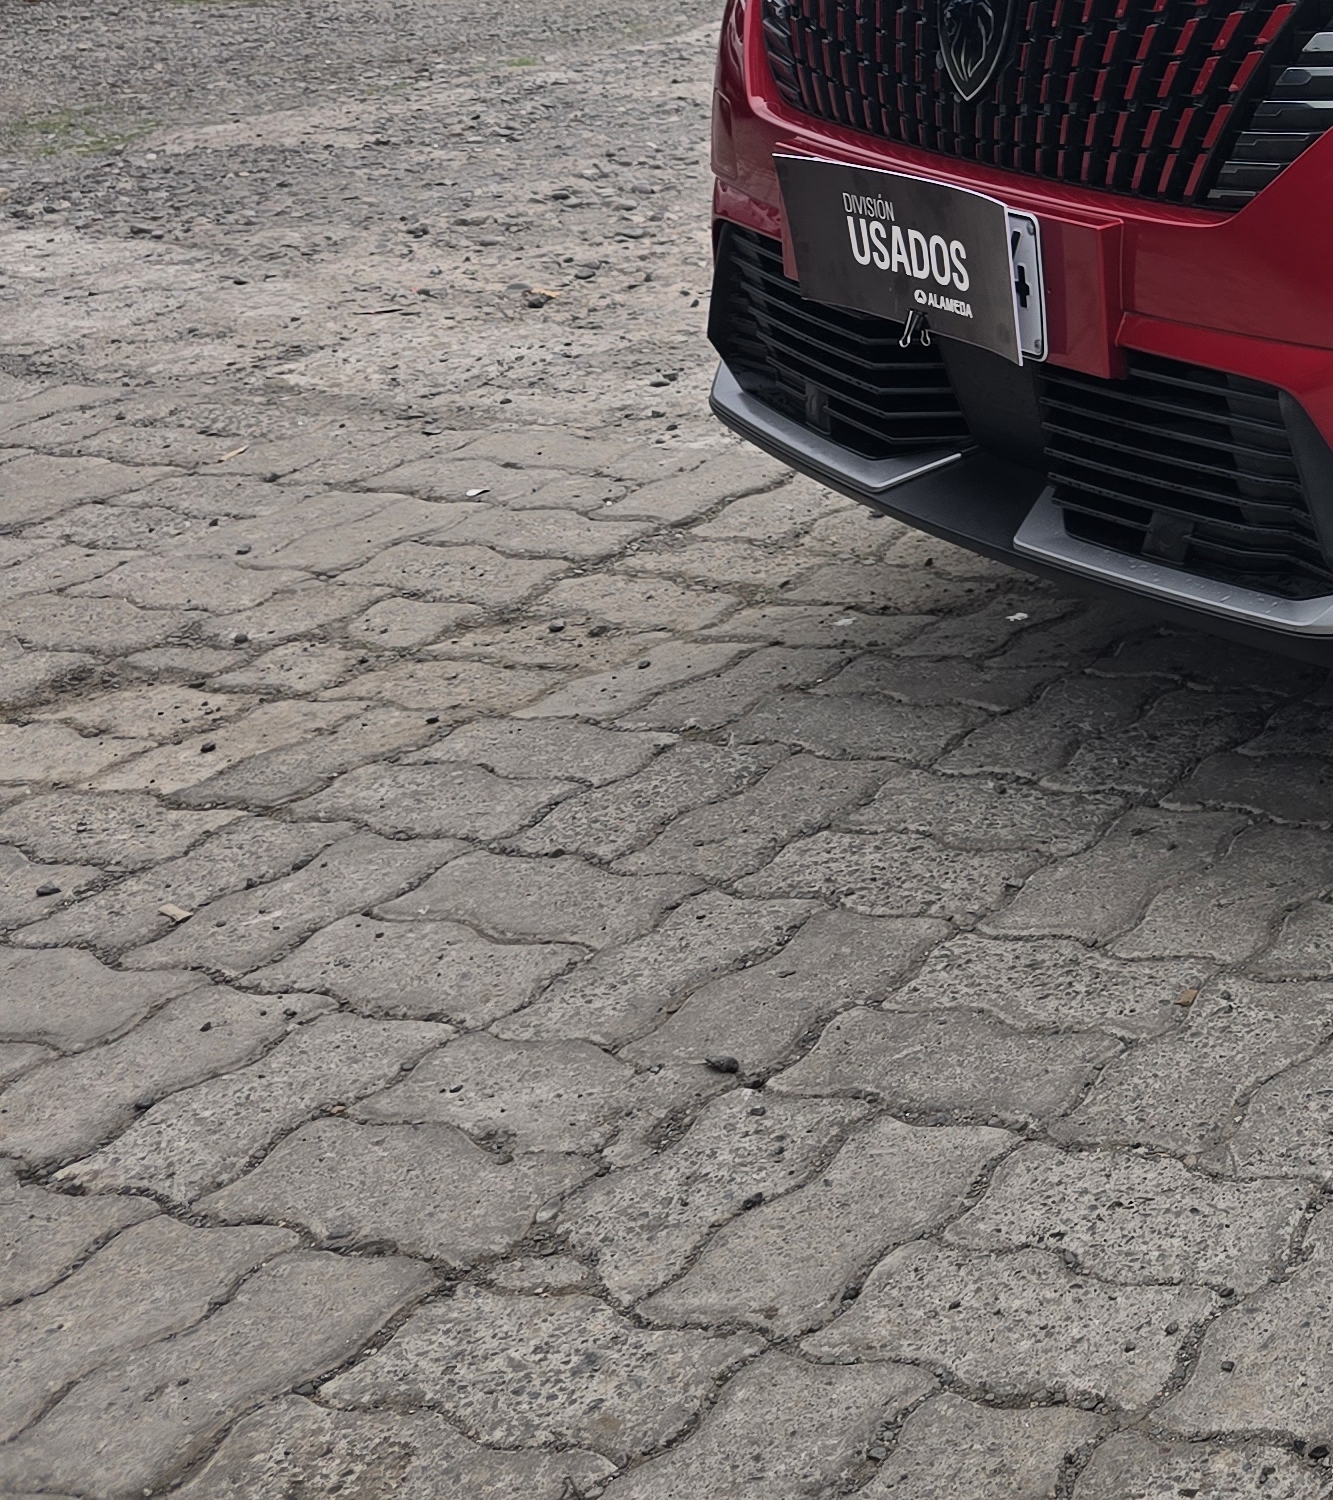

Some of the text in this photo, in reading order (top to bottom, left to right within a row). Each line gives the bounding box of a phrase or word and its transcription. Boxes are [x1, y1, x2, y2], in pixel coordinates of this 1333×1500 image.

[842, 192, 895, 221] DIVISIÓN
[846, 215, 970, 292] USADOS
[927, 292, 974, 319] ALAMEDA
